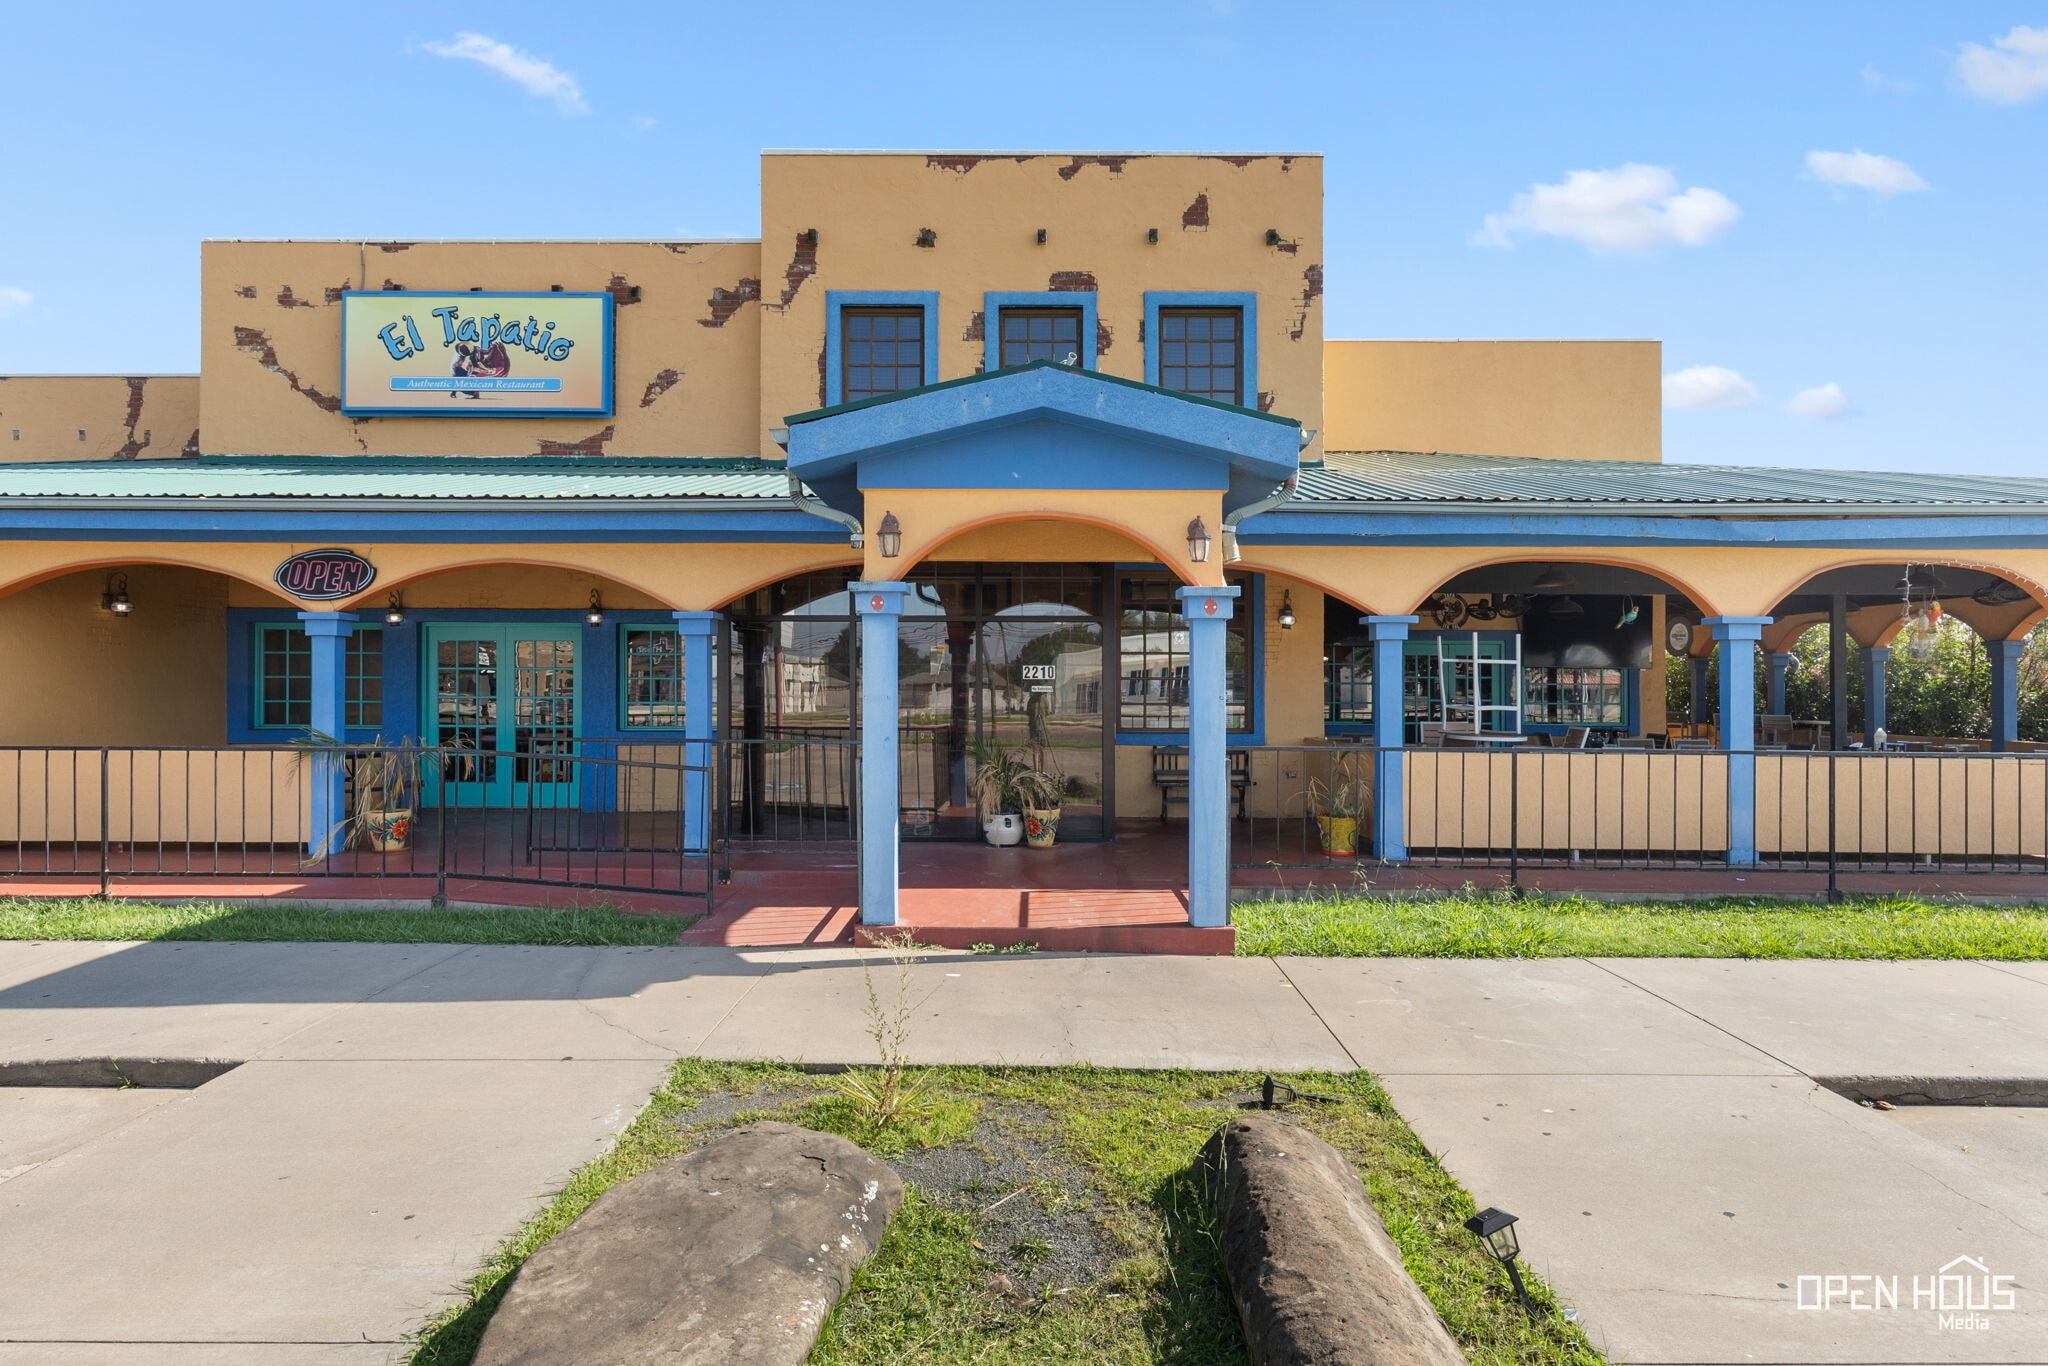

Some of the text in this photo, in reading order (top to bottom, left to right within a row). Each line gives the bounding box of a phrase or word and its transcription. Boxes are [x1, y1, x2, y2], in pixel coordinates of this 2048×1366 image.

[378, 306, 574, 361] El Tapatio
[407, 379, 545, 389] Authentic Mexican Restaurant
[286, 559, 363, 593] OPEN
[1023, 666, 1055, 679] 2210
